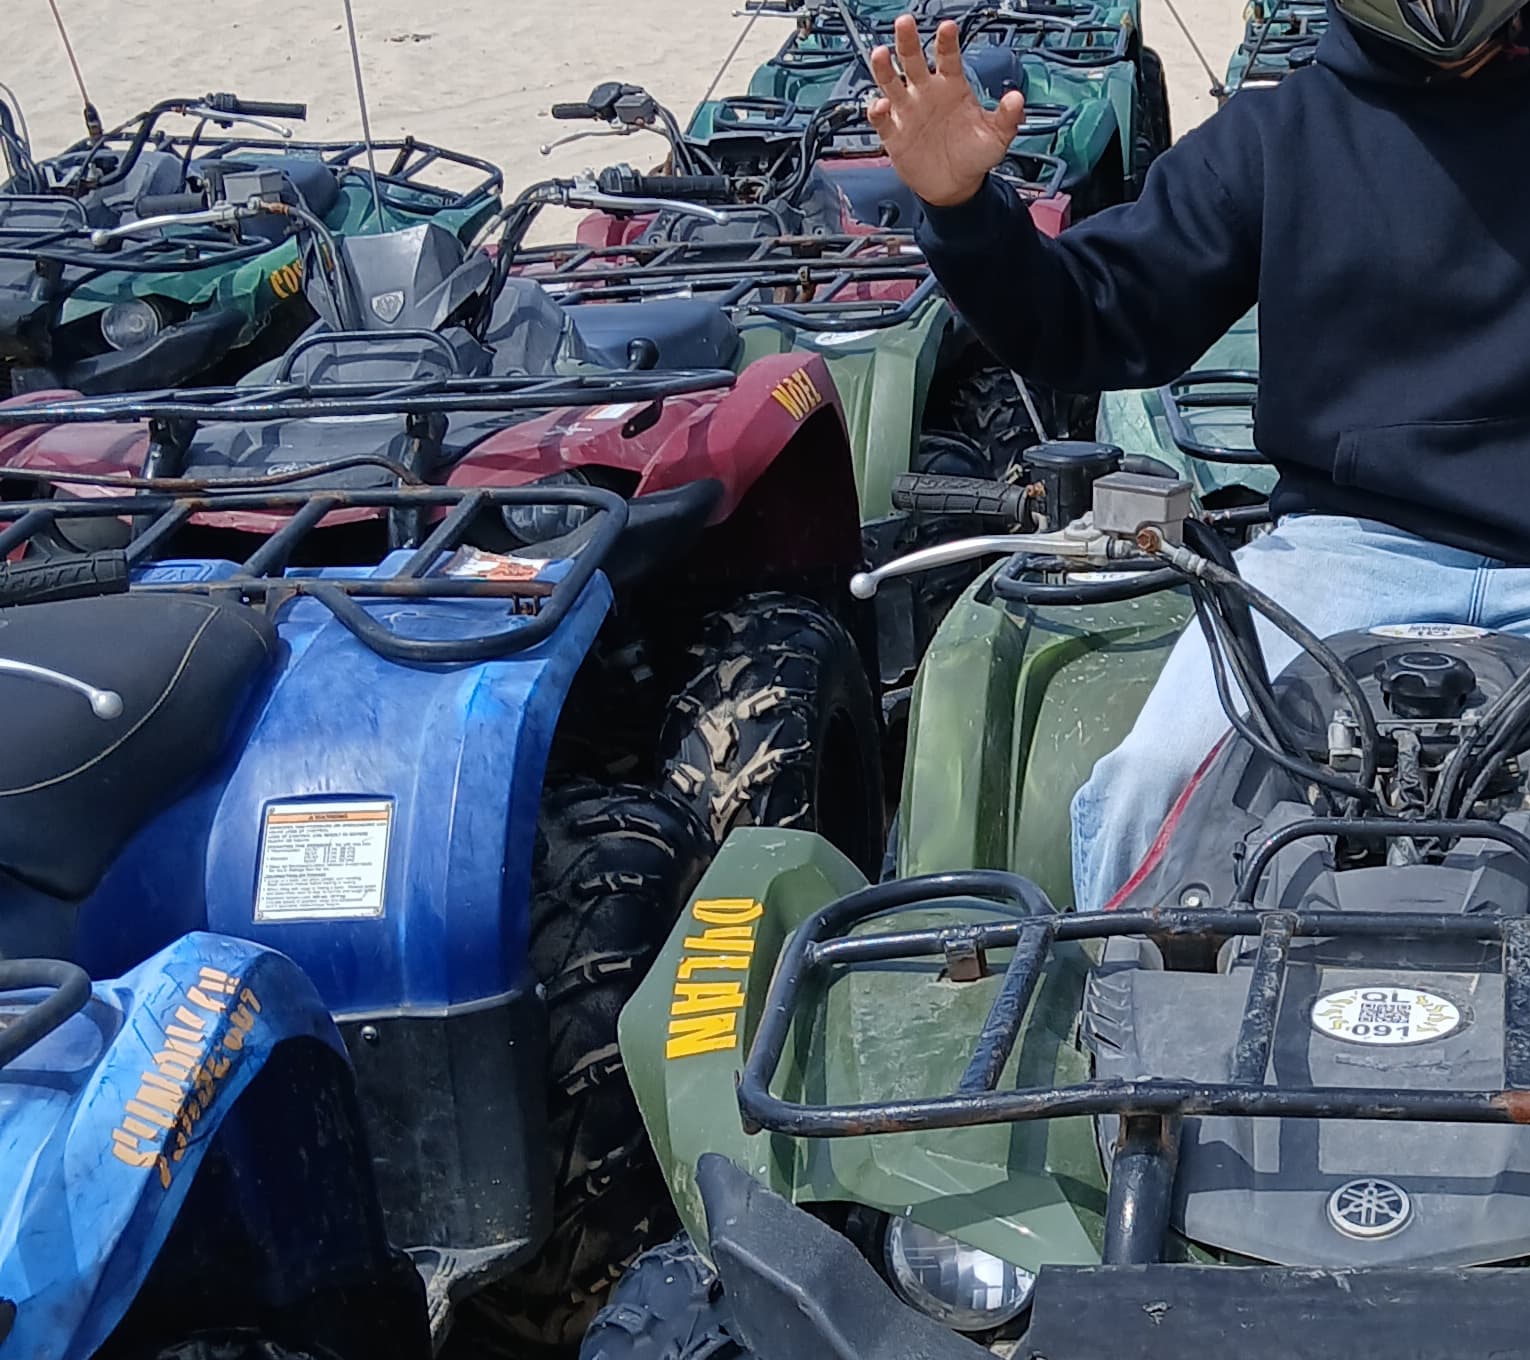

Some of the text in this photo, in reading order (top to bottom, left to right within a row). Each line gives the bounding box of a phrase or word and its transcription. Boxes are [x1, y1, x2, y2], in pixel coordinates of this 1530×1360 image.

[666, 898, 765, 1060] DYLAN
[1361, 991, 1411, 1004] QL
[1351, 1023, 1410, 1038] 091
